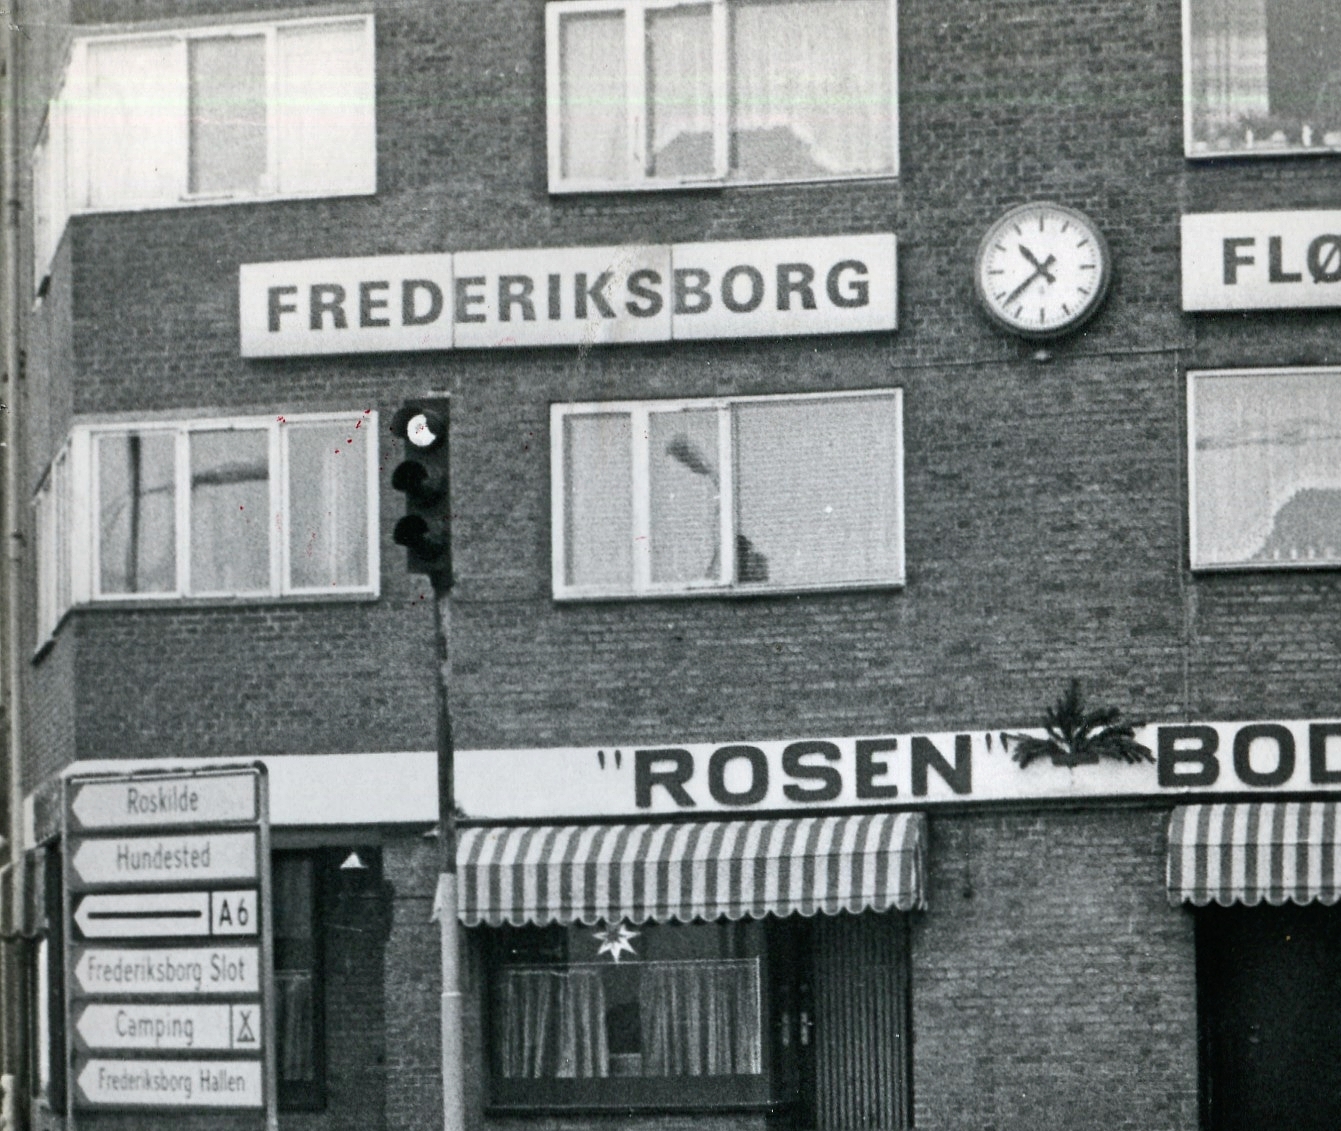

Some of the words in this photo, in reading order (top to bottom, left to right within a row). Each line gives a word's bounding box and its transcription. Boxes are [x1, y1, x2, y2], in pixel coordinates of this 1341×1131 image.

[267, 259, 871, 332] FREDERIKSBORG
[127, 785, 199, 814] Roskilde
[116, 841, 211, 871] Hundested
[87, 956, 202, 992] Frederiksborg
[210, 953, 245, 982] Slot
[116, 1009, 194, 1046] Camping
[99, 1067, 192, 1098] Frederiksborg
[200, 1070, 246, 1092] Hallen
